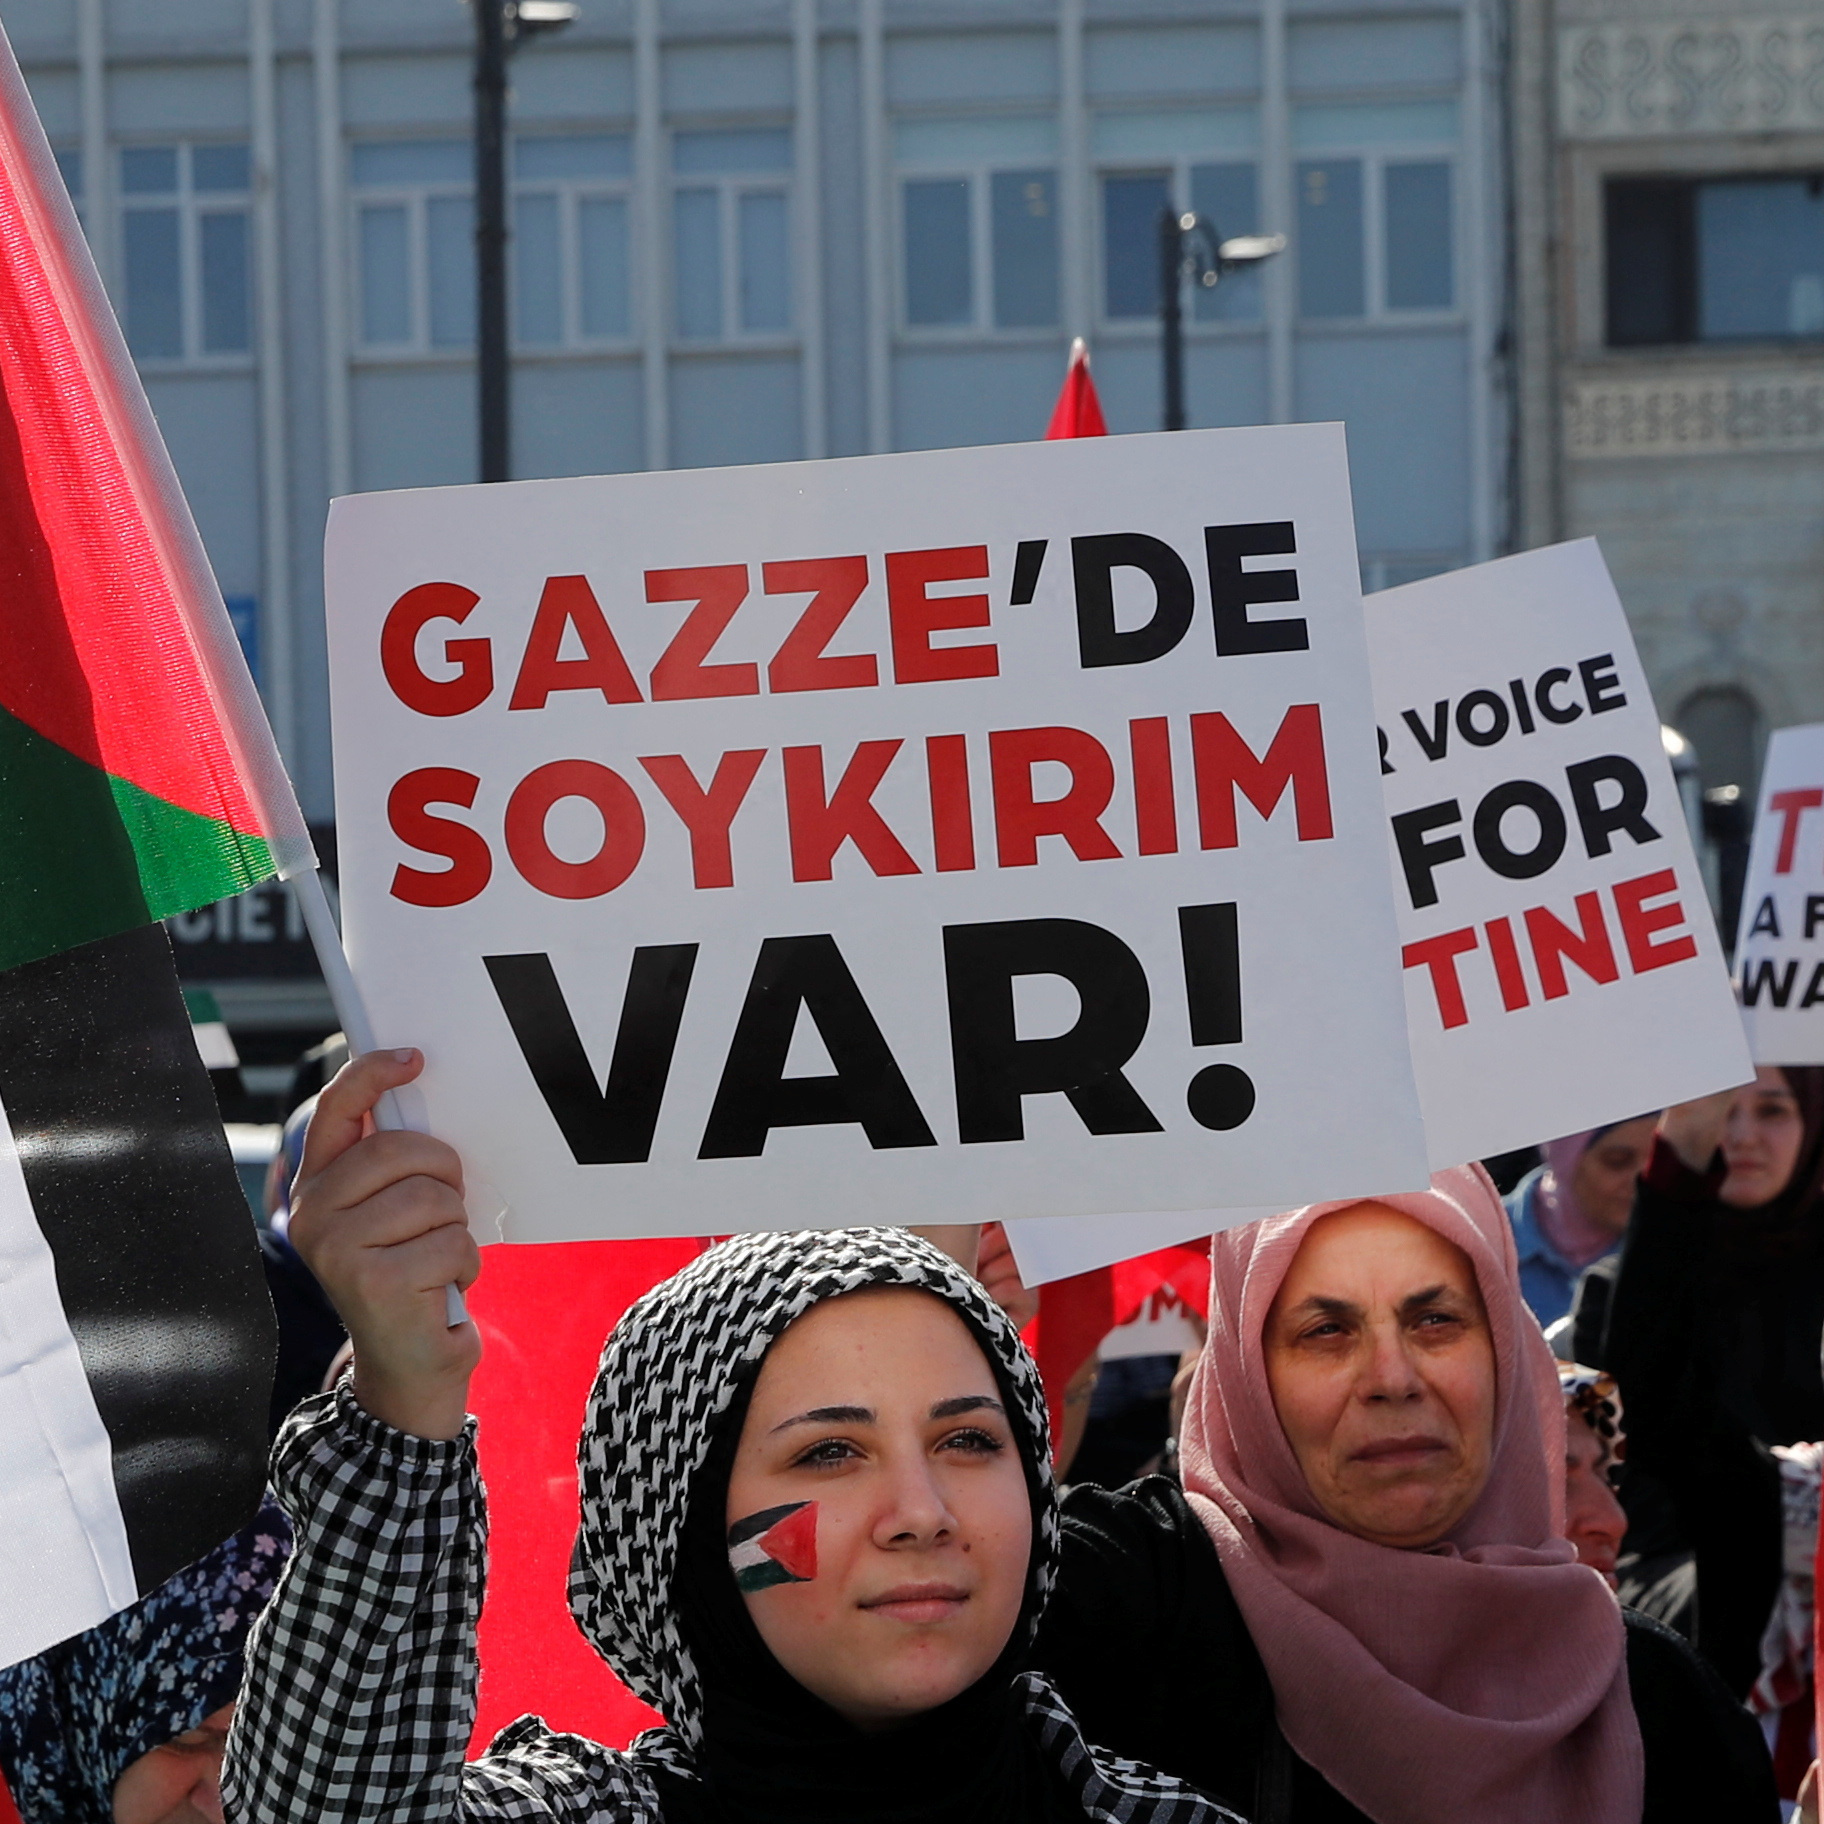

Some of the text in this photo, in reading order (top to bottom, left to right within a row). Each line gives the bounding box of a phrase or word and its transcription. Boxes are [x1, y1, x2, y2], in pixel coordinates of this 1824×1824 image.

[1401, 653, 1627, 762] VOICE
[387, 703, 1334, 908] SOYKIRIM
[1391, 754, 1662, 909] FOR
[1749, 895, 1780, 939] A
[482, 901, 1255, 1165] VAR!
